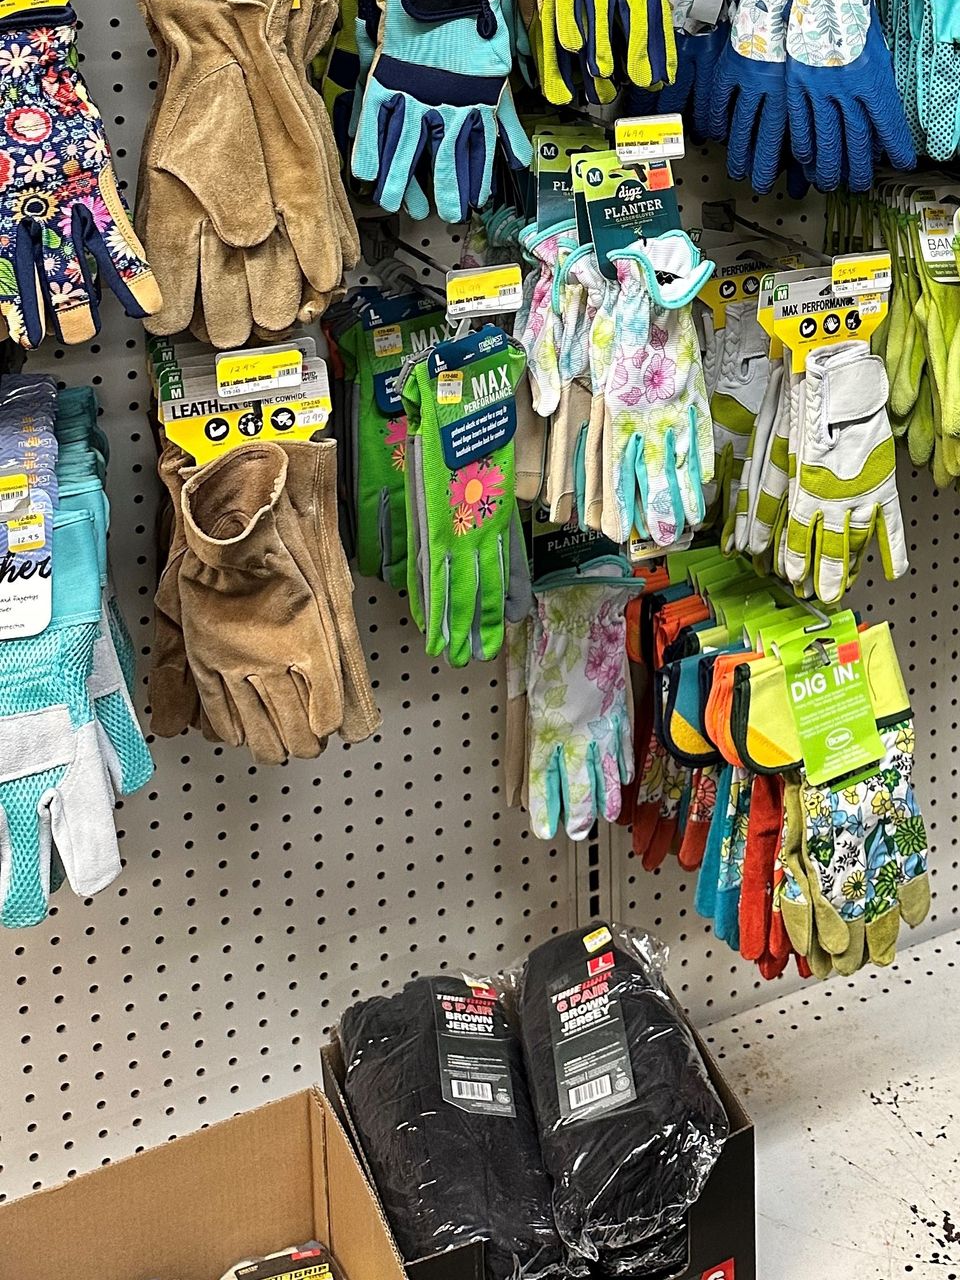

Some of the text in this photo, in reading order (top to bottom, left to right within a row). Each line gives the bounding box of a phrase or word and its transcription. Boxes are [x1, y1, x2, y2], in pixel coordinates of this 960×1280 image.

[544, 145, 556, 157] M
[589, 172, 601, 183] M
[618, 185, 643, 201] digz
[604, 198, 664, 220] PLANTER
[765, 279, 774, 290] M
[777, 290, 788, 301] M
[370, 309, 379, 320] L
[782, 303, 798, 317] MAX
[410, 323, 451, 353] MAX
[435, 353, 445, 366] L
[435, 365, 448, 373] LARGE
[471, 364, 509, 400] MAX
[170, 389, 182, 400] M
[276, 392, 308, 404] COWHIDE
[464, 386, 513, 414] PERFORMANCE
[547, 526, 604, 553] PLANTER
[790, 661, 861, 704] DIG IN.
[437, 993, 466, 1003] TRUE
[551, 983, 582, 1004] TRUE
[556, 981, 610, 1014] 6 PAIR
[442, 1001, 494, 1016] 6 PAIR
[560, 995, 609, 1023] BROWN
[446, 1011, 493, 1025] BROWN
[560, 1006, 611, 1034] JERSEY
[446, 1021, 495, 1034] JERSEY
